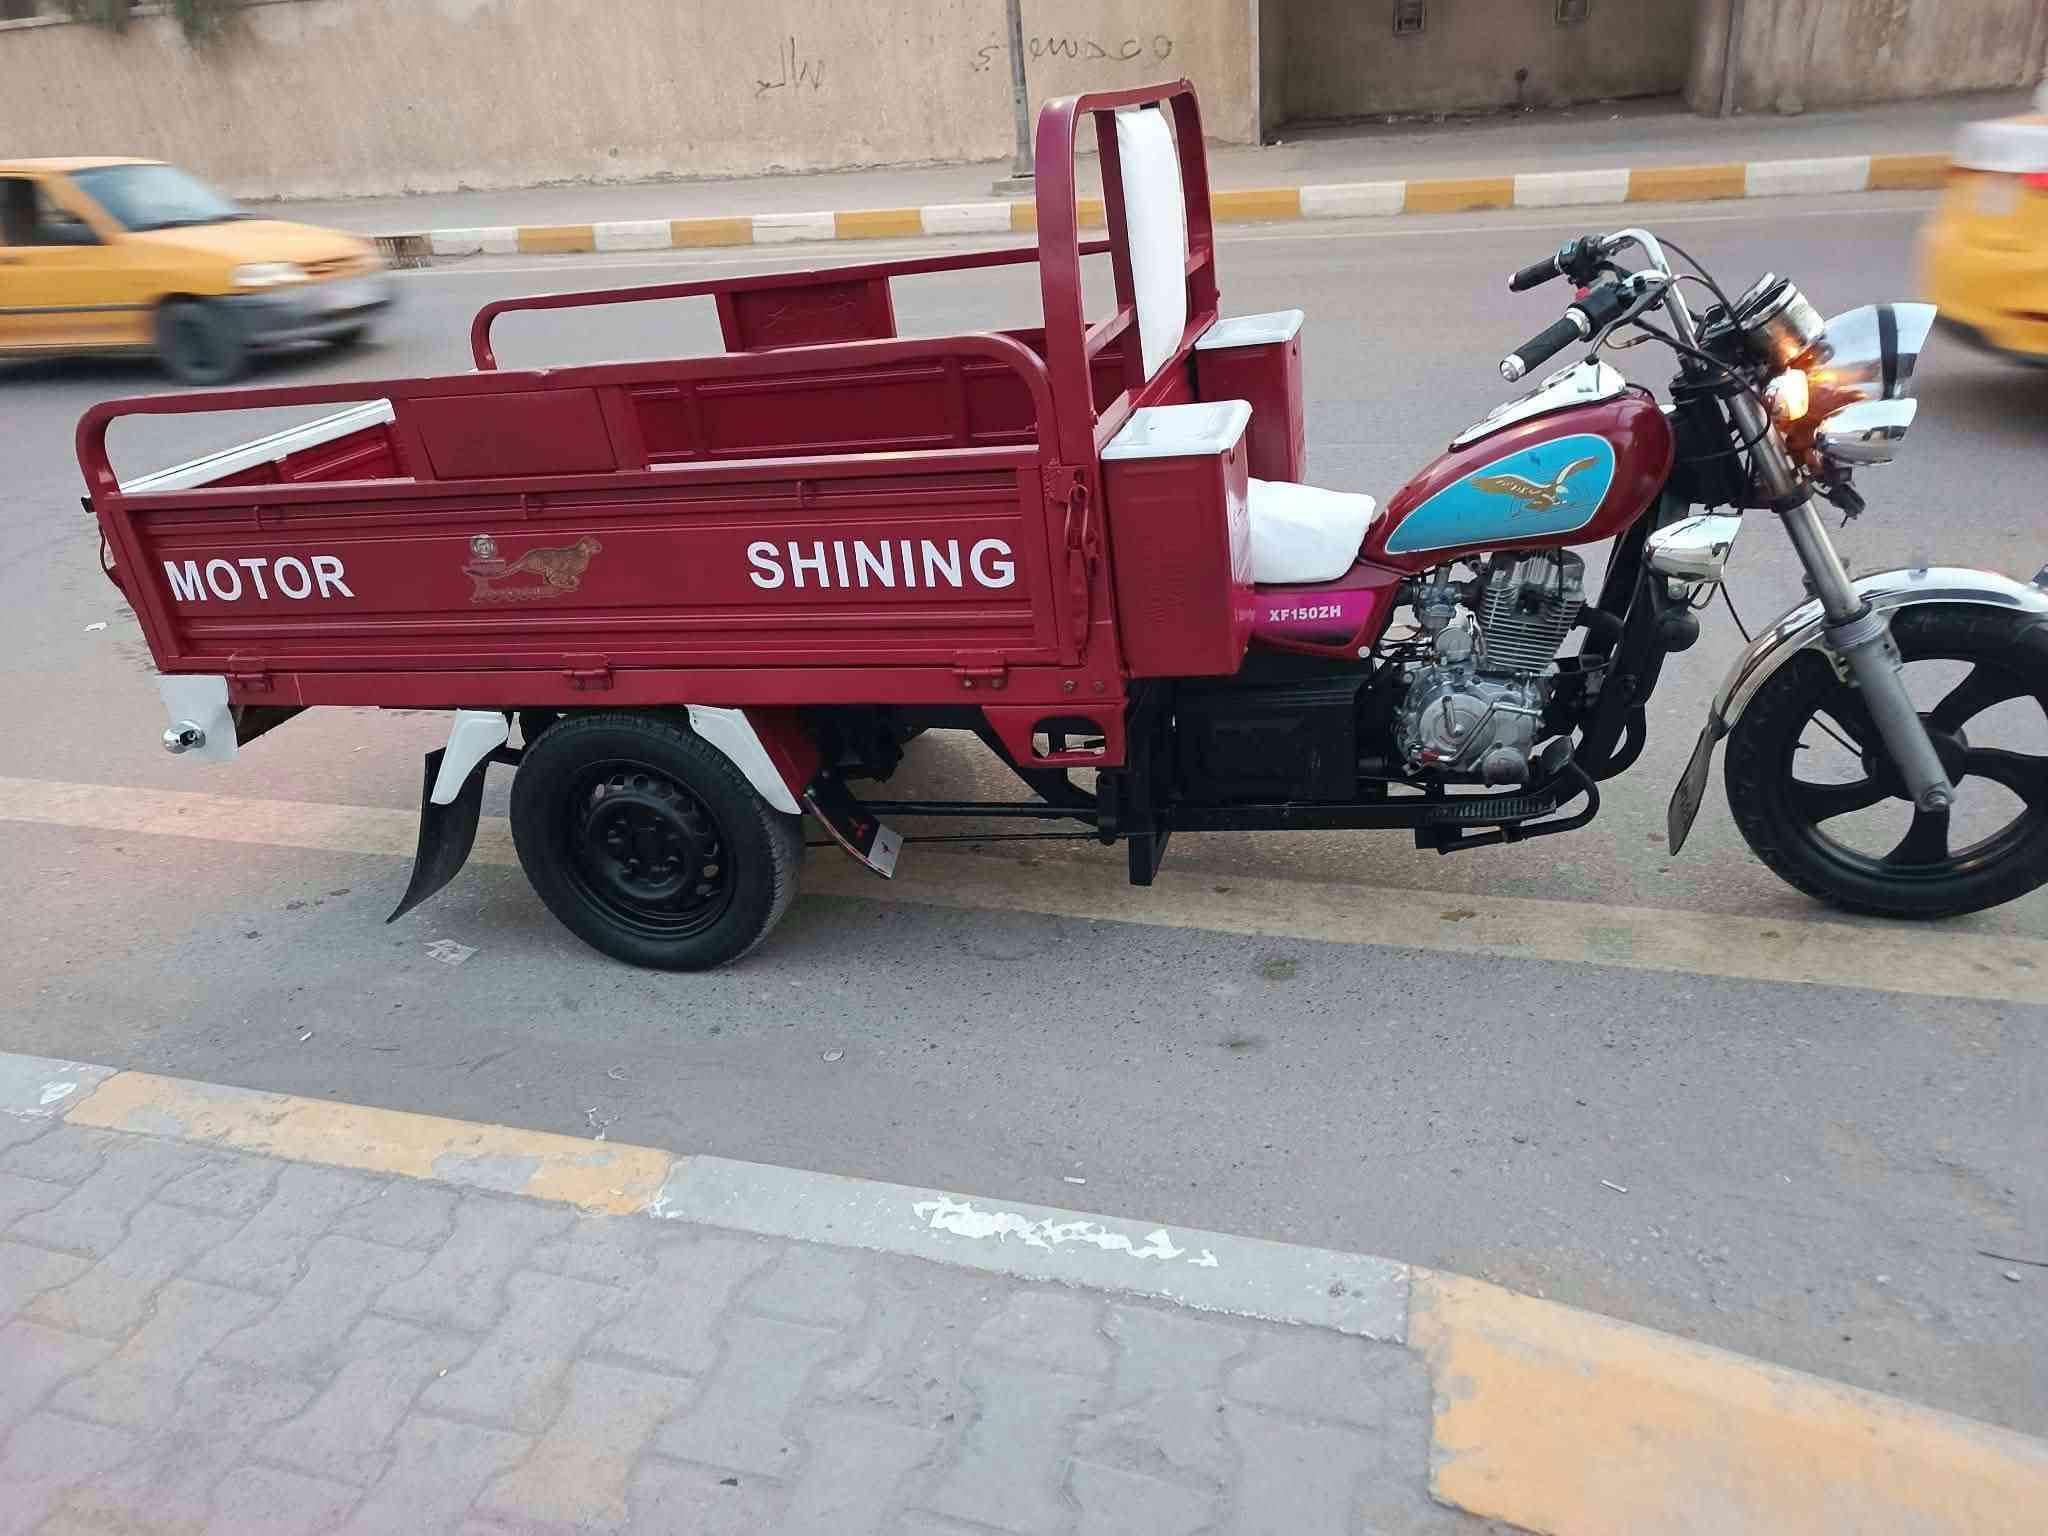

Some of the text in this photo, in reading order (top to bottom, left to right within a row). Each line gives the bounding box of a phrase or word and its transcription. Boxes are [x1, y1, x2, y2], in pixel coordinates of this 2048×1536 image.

[163, 555, 355, 601] MOTOR
[747, 538, 1016, 589] SHINING
[1269, 605, 1341, 622] XF150ZH
